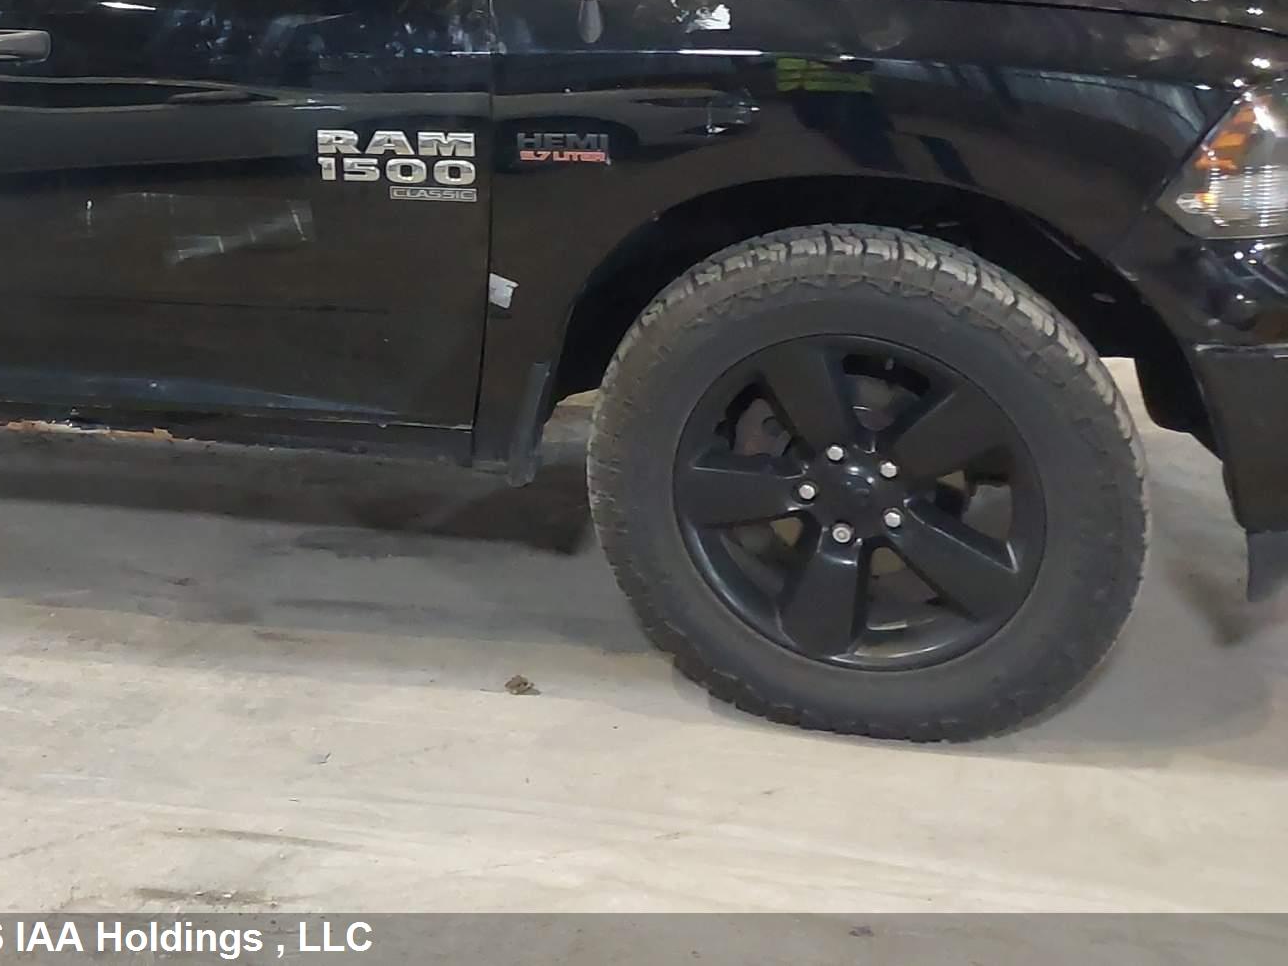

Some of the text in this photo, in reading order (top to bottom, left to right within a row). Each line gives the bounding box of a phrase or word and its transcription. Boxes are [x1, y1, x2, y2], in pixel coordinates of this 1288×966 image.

[316, 129, 476, 157] RAM
[517, 132, 609, 150] HEMI
[317, 156, 477, 185] 1500
[393, 188, 475, 200] CLASSIC
